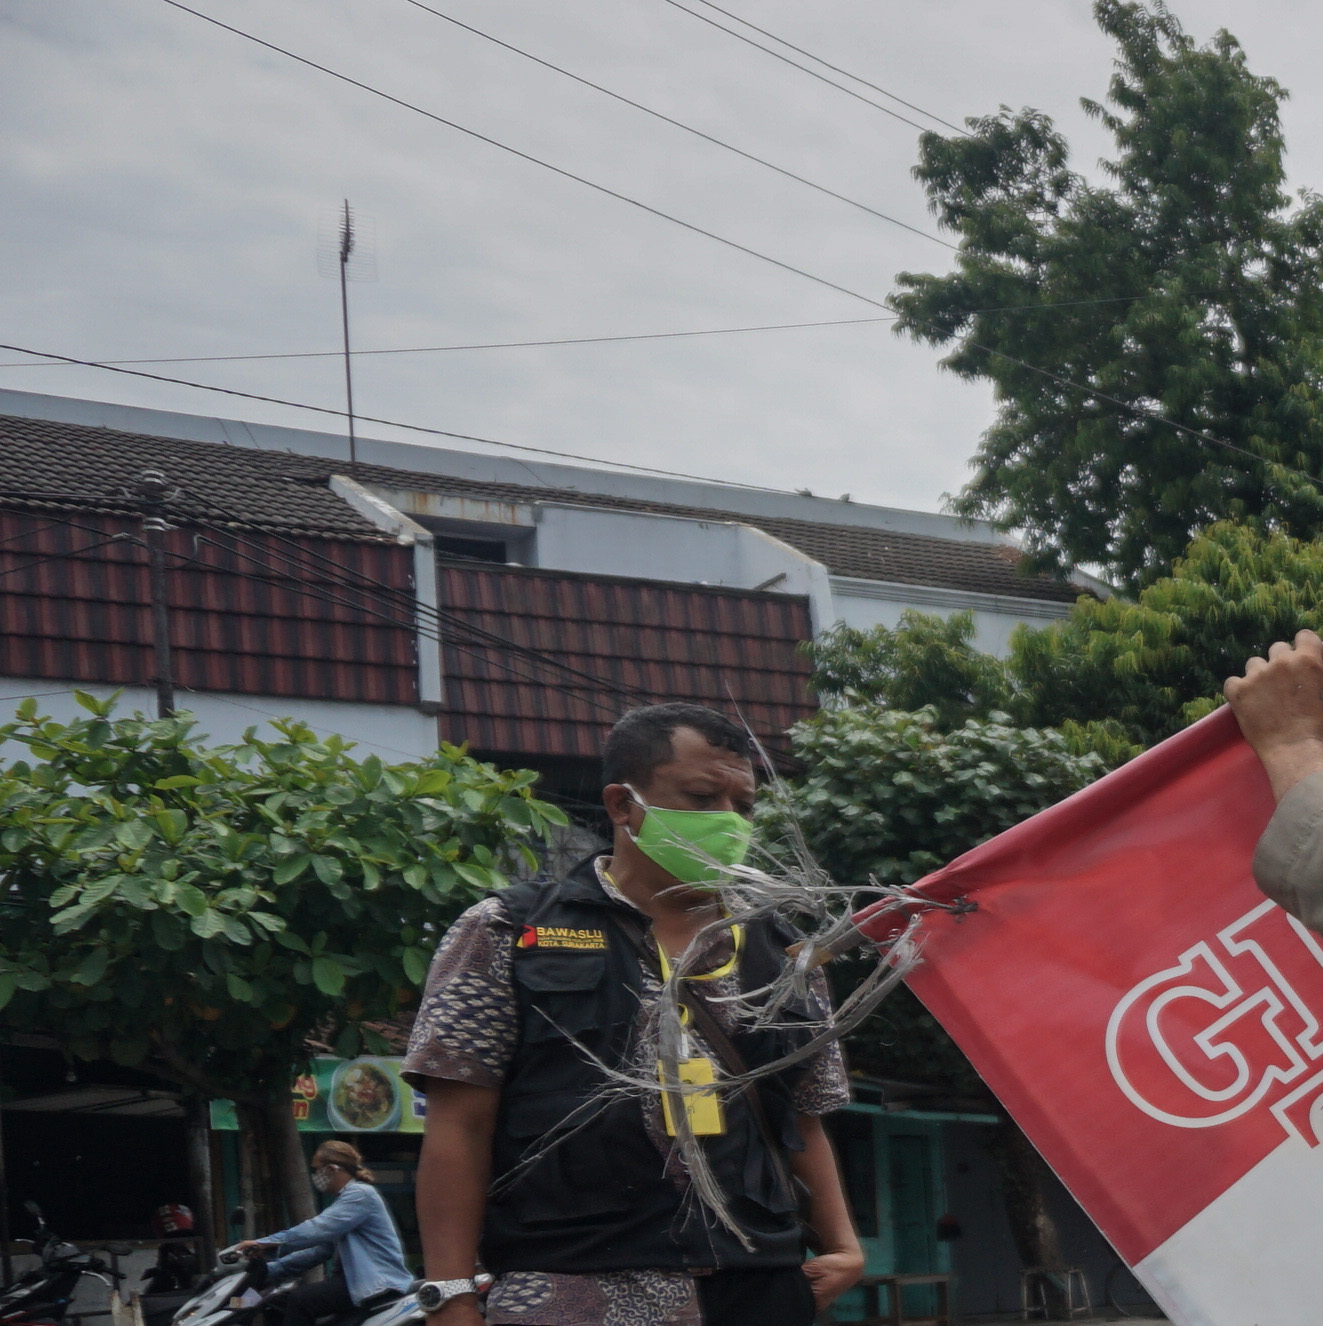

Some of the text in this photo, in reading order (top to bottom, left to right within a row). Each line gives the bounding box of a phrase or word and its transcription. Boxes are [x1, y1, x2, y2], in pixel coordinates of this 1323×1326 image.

[536, 926, 602, 939] BAWASLU
[537, 940, 606, 949] KOTA SURAKARTA
